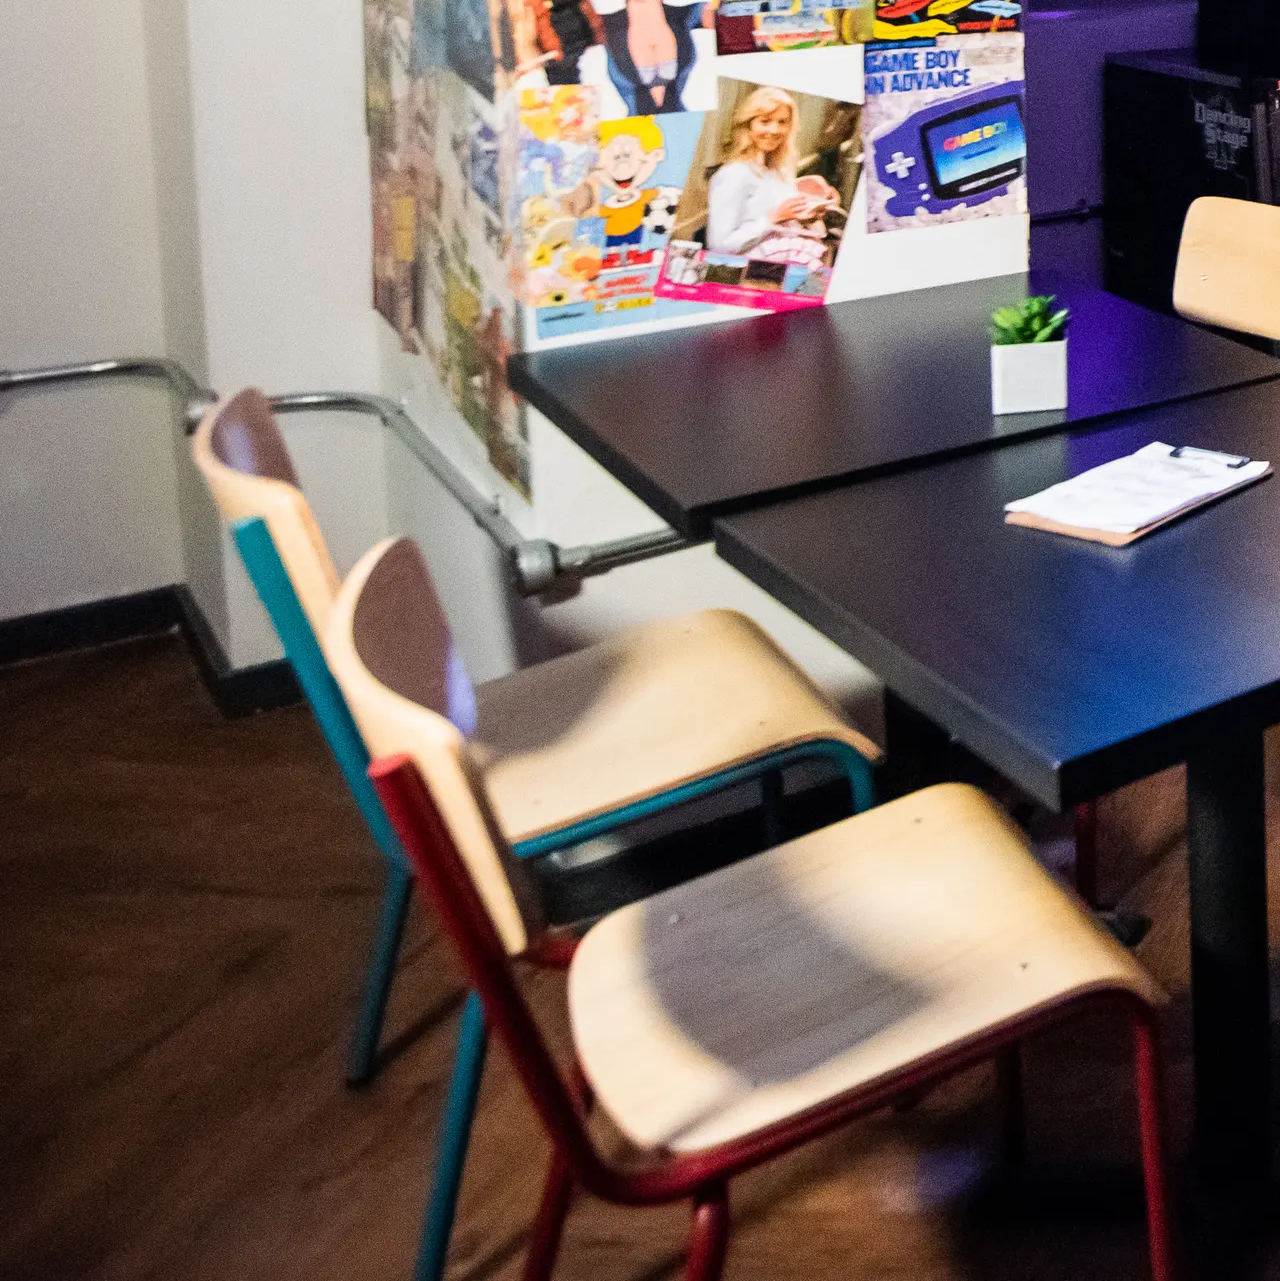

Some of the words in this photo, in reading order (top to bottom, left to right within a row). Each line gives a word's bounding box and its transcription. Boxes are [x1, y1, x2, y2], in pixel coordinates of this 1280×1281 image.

[865, 52, 920, 74] GAME
[925, 49, 961, 70] BOY
[890, 68, 971, 92] ADVANCE
